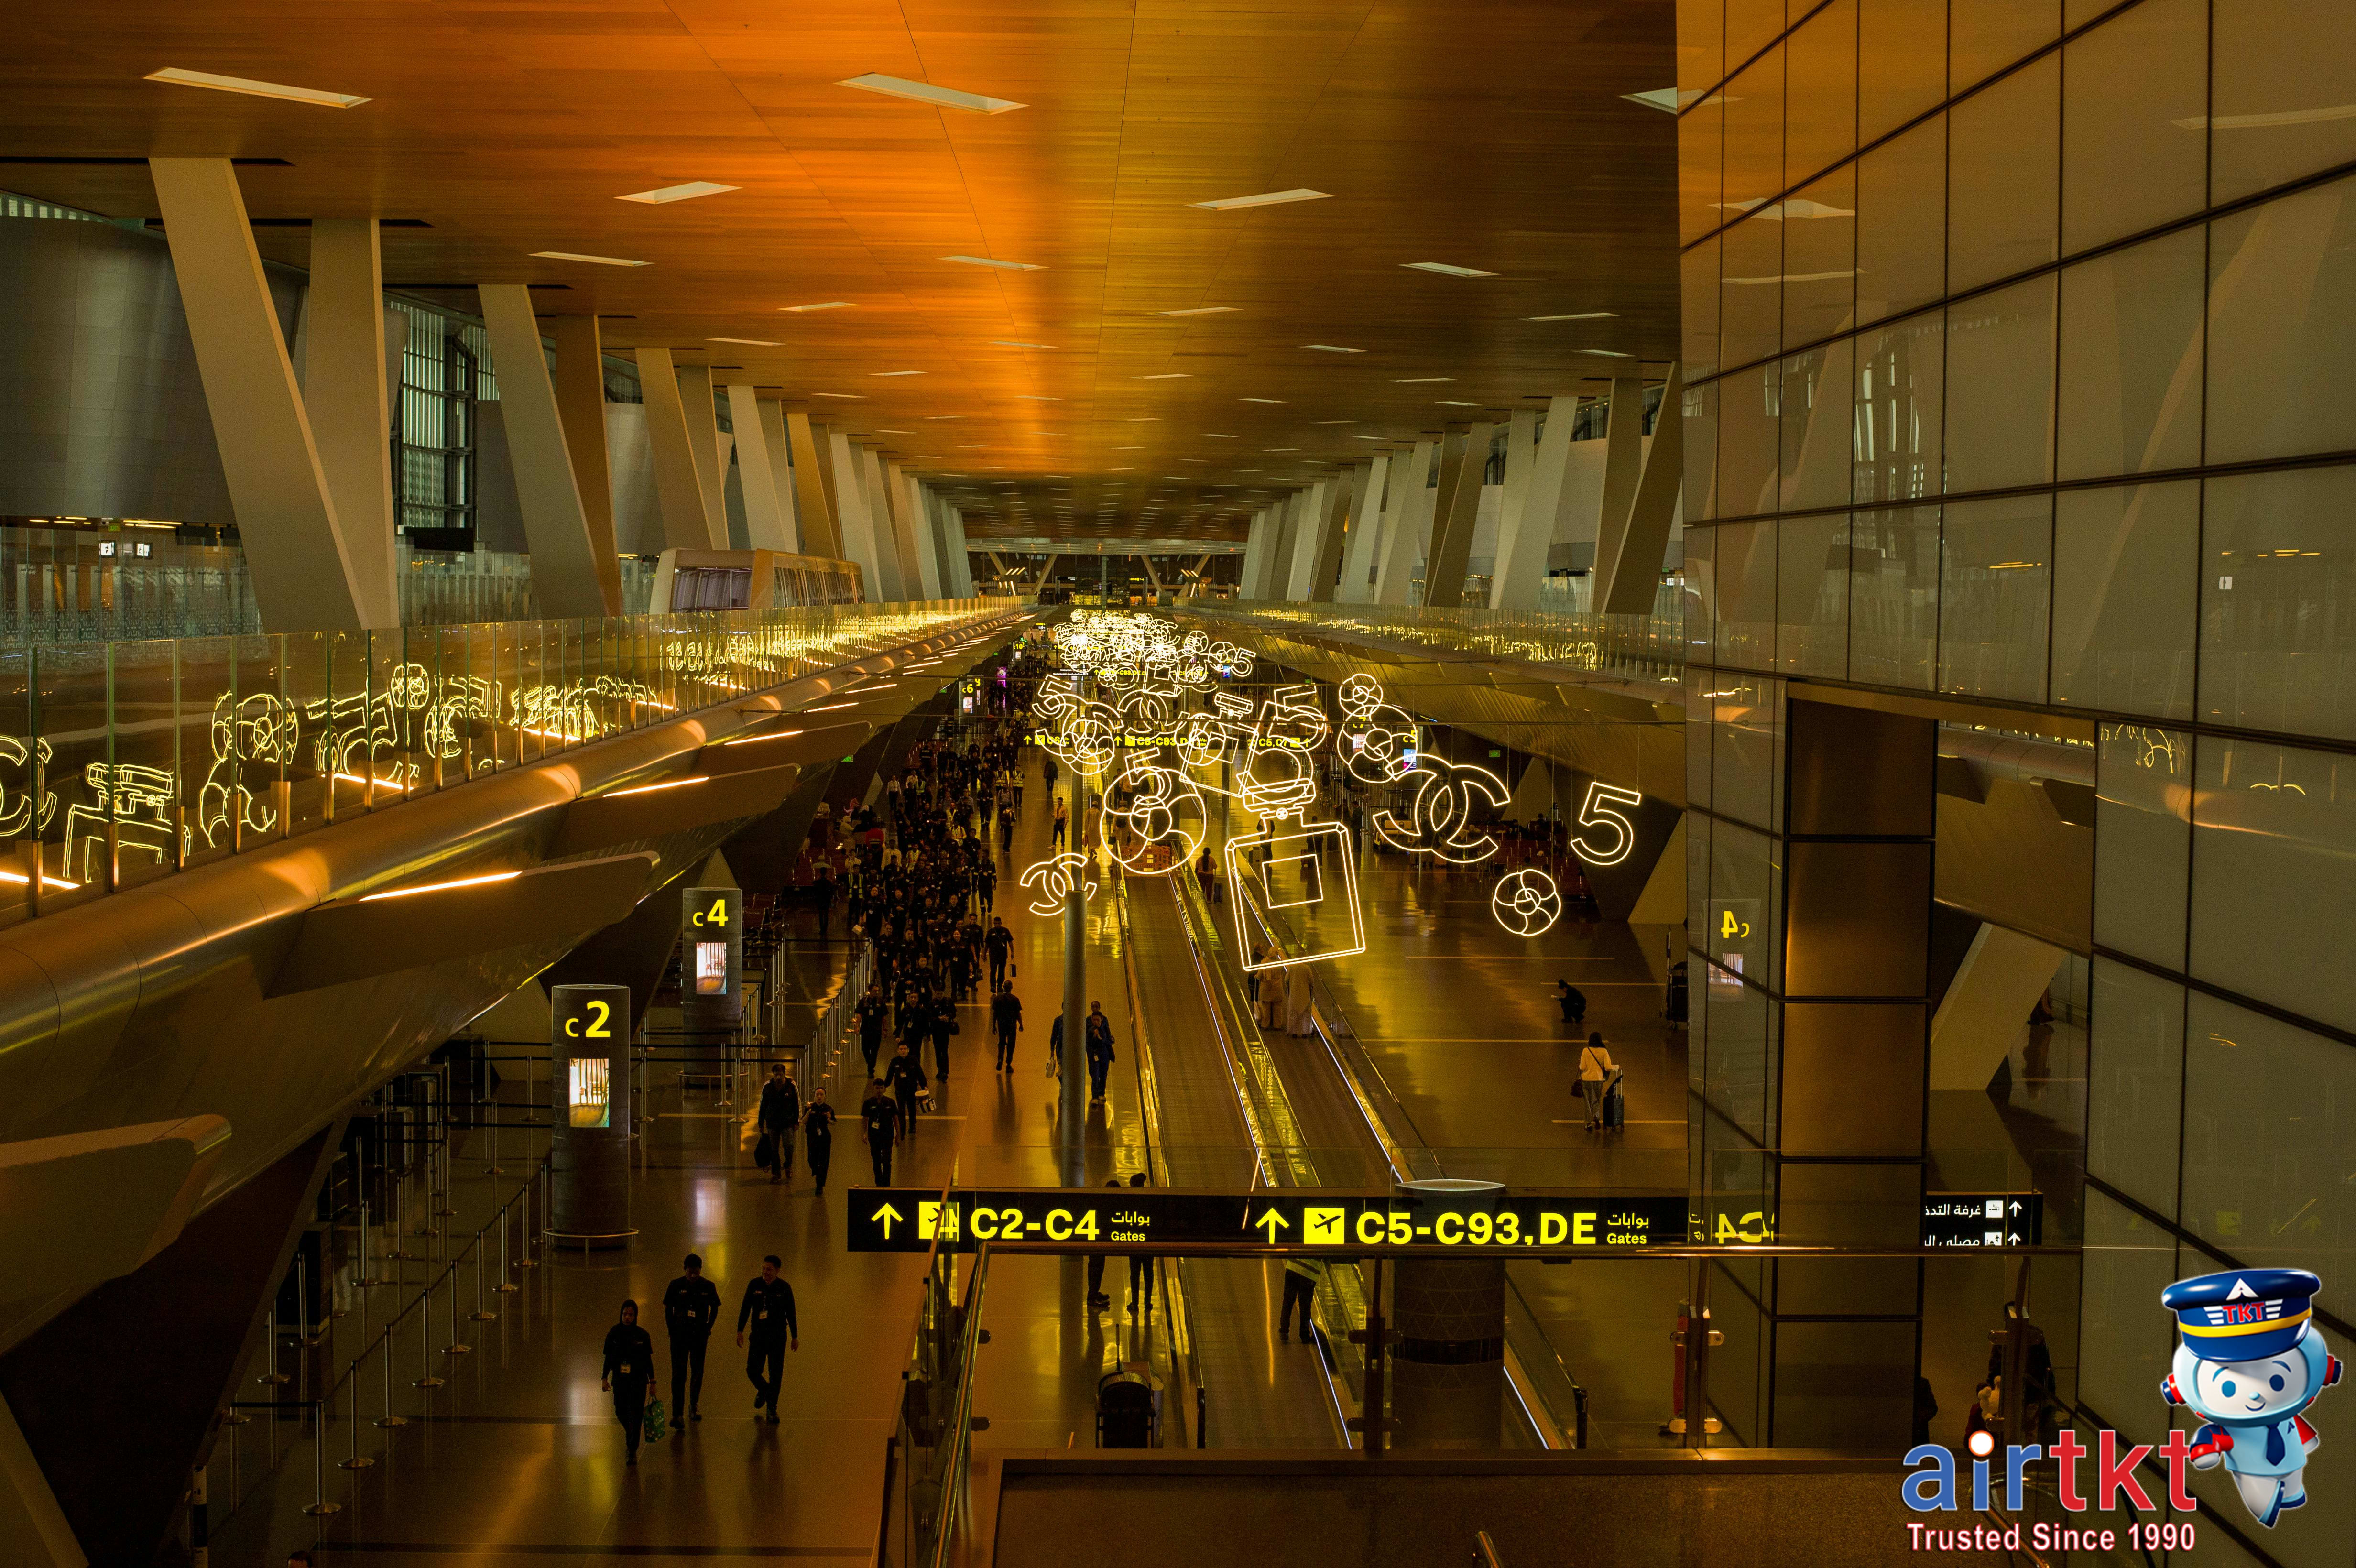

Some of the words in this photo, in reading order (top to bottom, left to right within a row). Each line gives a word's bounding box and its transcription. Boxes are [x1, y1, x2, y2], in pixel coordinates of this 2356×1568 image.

[962, 684, 973, 693] c6
[1571, 782, 1641, 865] 5
[693, 899, 728, 926] c4
[565, 1001, 611, 1037] c2
[1111, 1211, 1150, 1226] بوابات
[1953, 1205, 1981, 1218] غرفة
[971, 1208, 1100, 1241] C2-C4
[1607, 1212, 1649, 1228] بوابات
[1111, 1231, 1145, 1241] Gates
[1607, 1232, 1647, 1244] Gates
